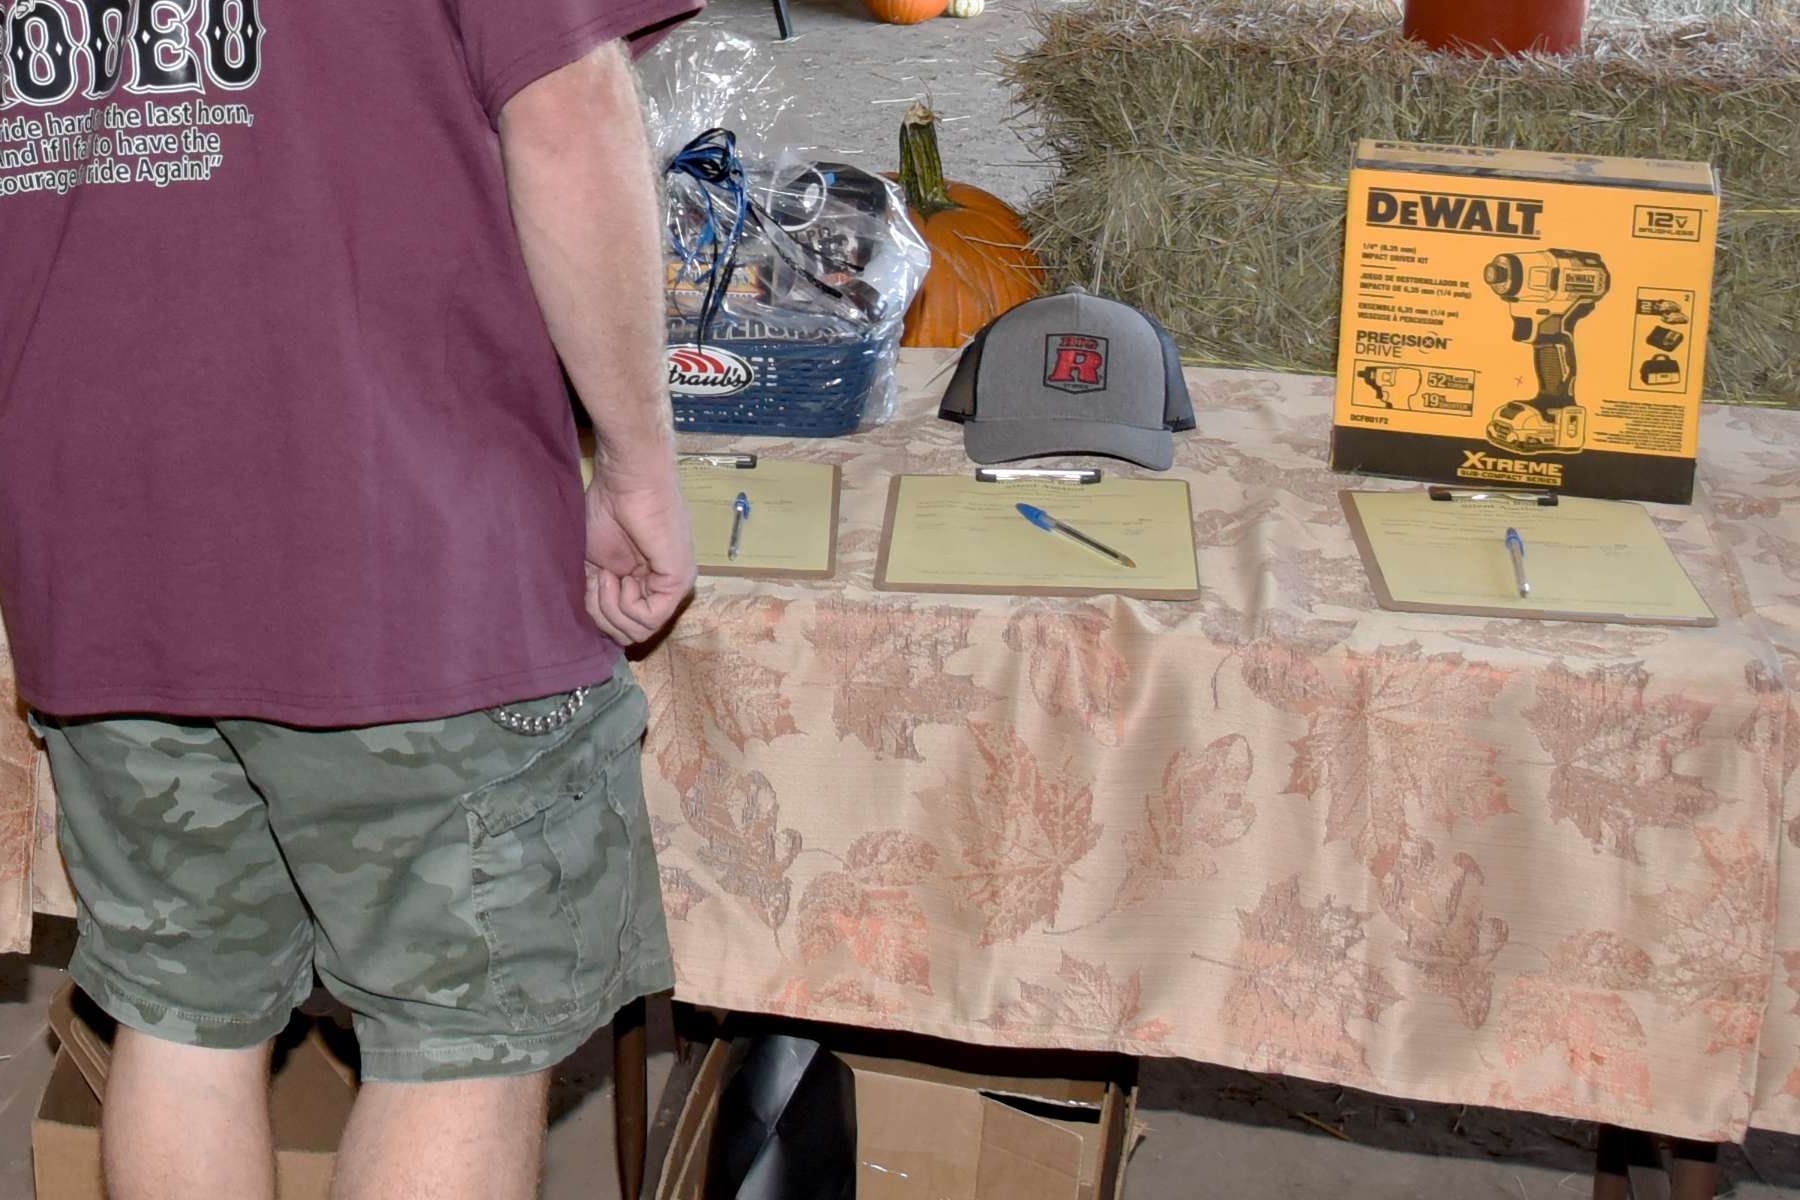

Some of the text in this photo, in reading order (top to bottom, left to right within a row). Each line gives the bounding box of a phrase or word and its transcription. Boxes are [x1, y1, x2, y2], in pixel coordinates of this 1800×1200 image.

[46, 108, 94, 136] hard
[103, 103, 141, 129] the
[145, 100, 193, 127] last
[196, 99, 255, 127] horn,
[40, 138, 60, 163] if
[62, 138, 72, 162] I
[116, 130, 178, 155] have
[182, 127, 221, 153] the
[86, 158, 131, 184] ride
[1361, 252, 1429, 264] IMPACT DRIVER KIT
[1355, 342, 1402, 359] DRIVE
[1356, 329, 1448, 350] PRECISION
[668, 362, 747, 388] traub's
[1047, 347, 1103, 384] R
[1461, 449, 1563, 477] XTREME
